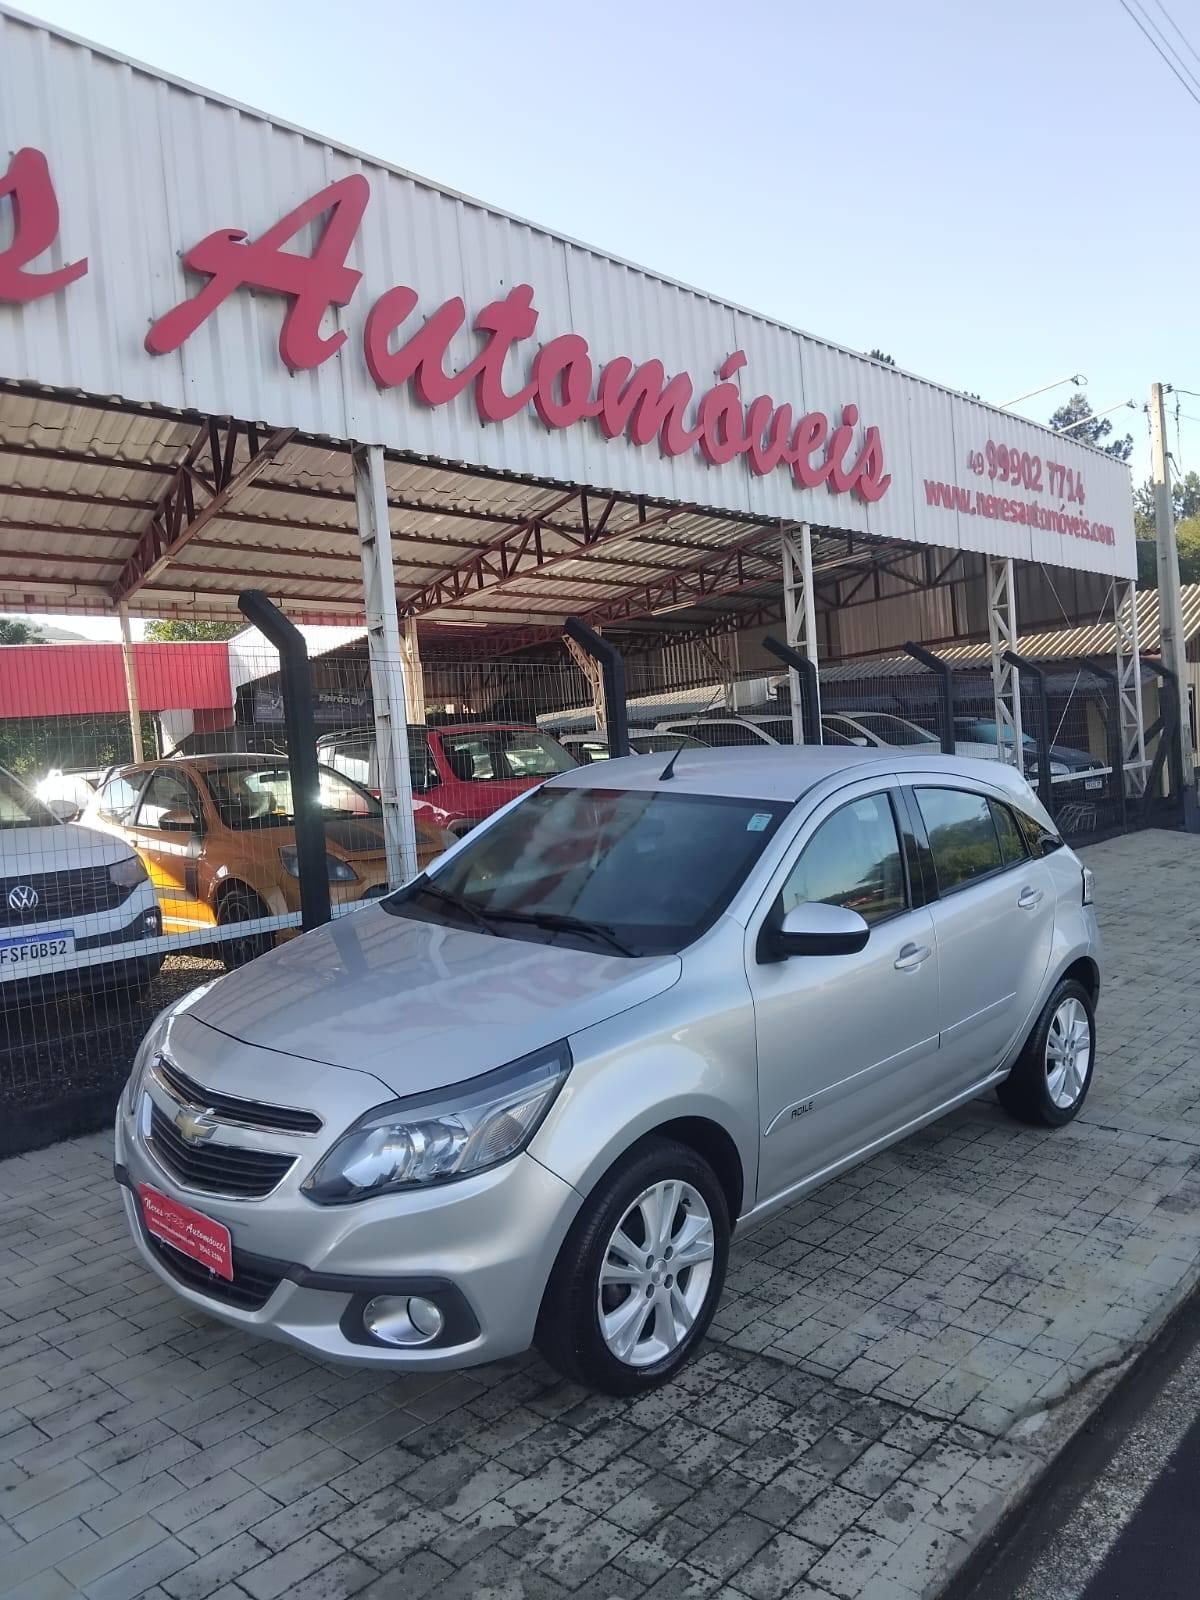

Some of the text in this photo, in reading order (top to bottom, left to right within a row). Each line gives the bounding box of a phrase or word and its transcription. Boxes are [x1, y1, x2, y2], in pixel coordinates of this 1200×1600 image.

[144, 173, 891, 503] Automóveis
[967, 439, 1086, 506] 49 99902 7714
